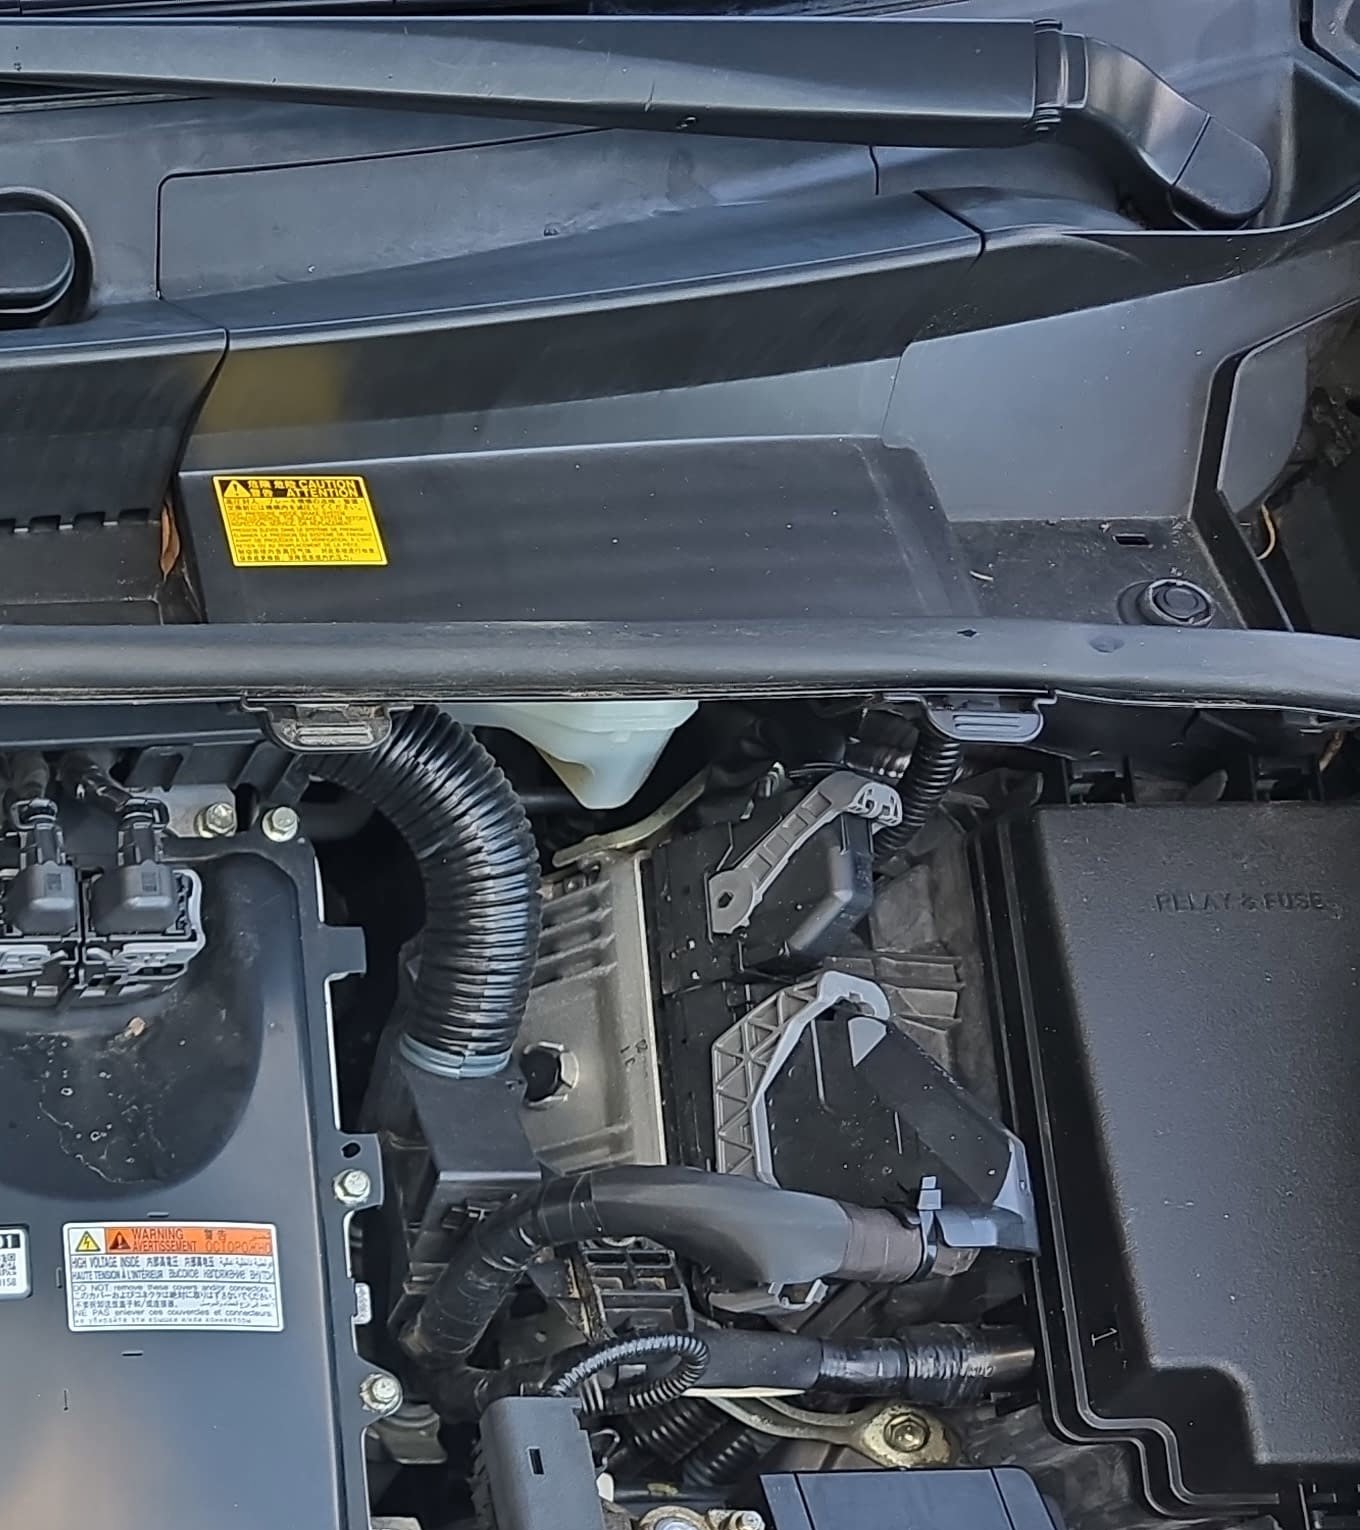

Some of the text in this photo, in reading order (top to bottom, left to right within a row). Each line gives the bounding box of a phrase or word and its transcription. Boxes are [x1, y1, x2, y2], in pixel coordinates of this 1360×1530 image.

[298, 480, 356, 488] CAUTION
[285, 488, 358, 497] ATTENTION
[131, 1228, 183, 1239] WARNING
[131, 1240, 197, 1251] AVERTISSEMENT
